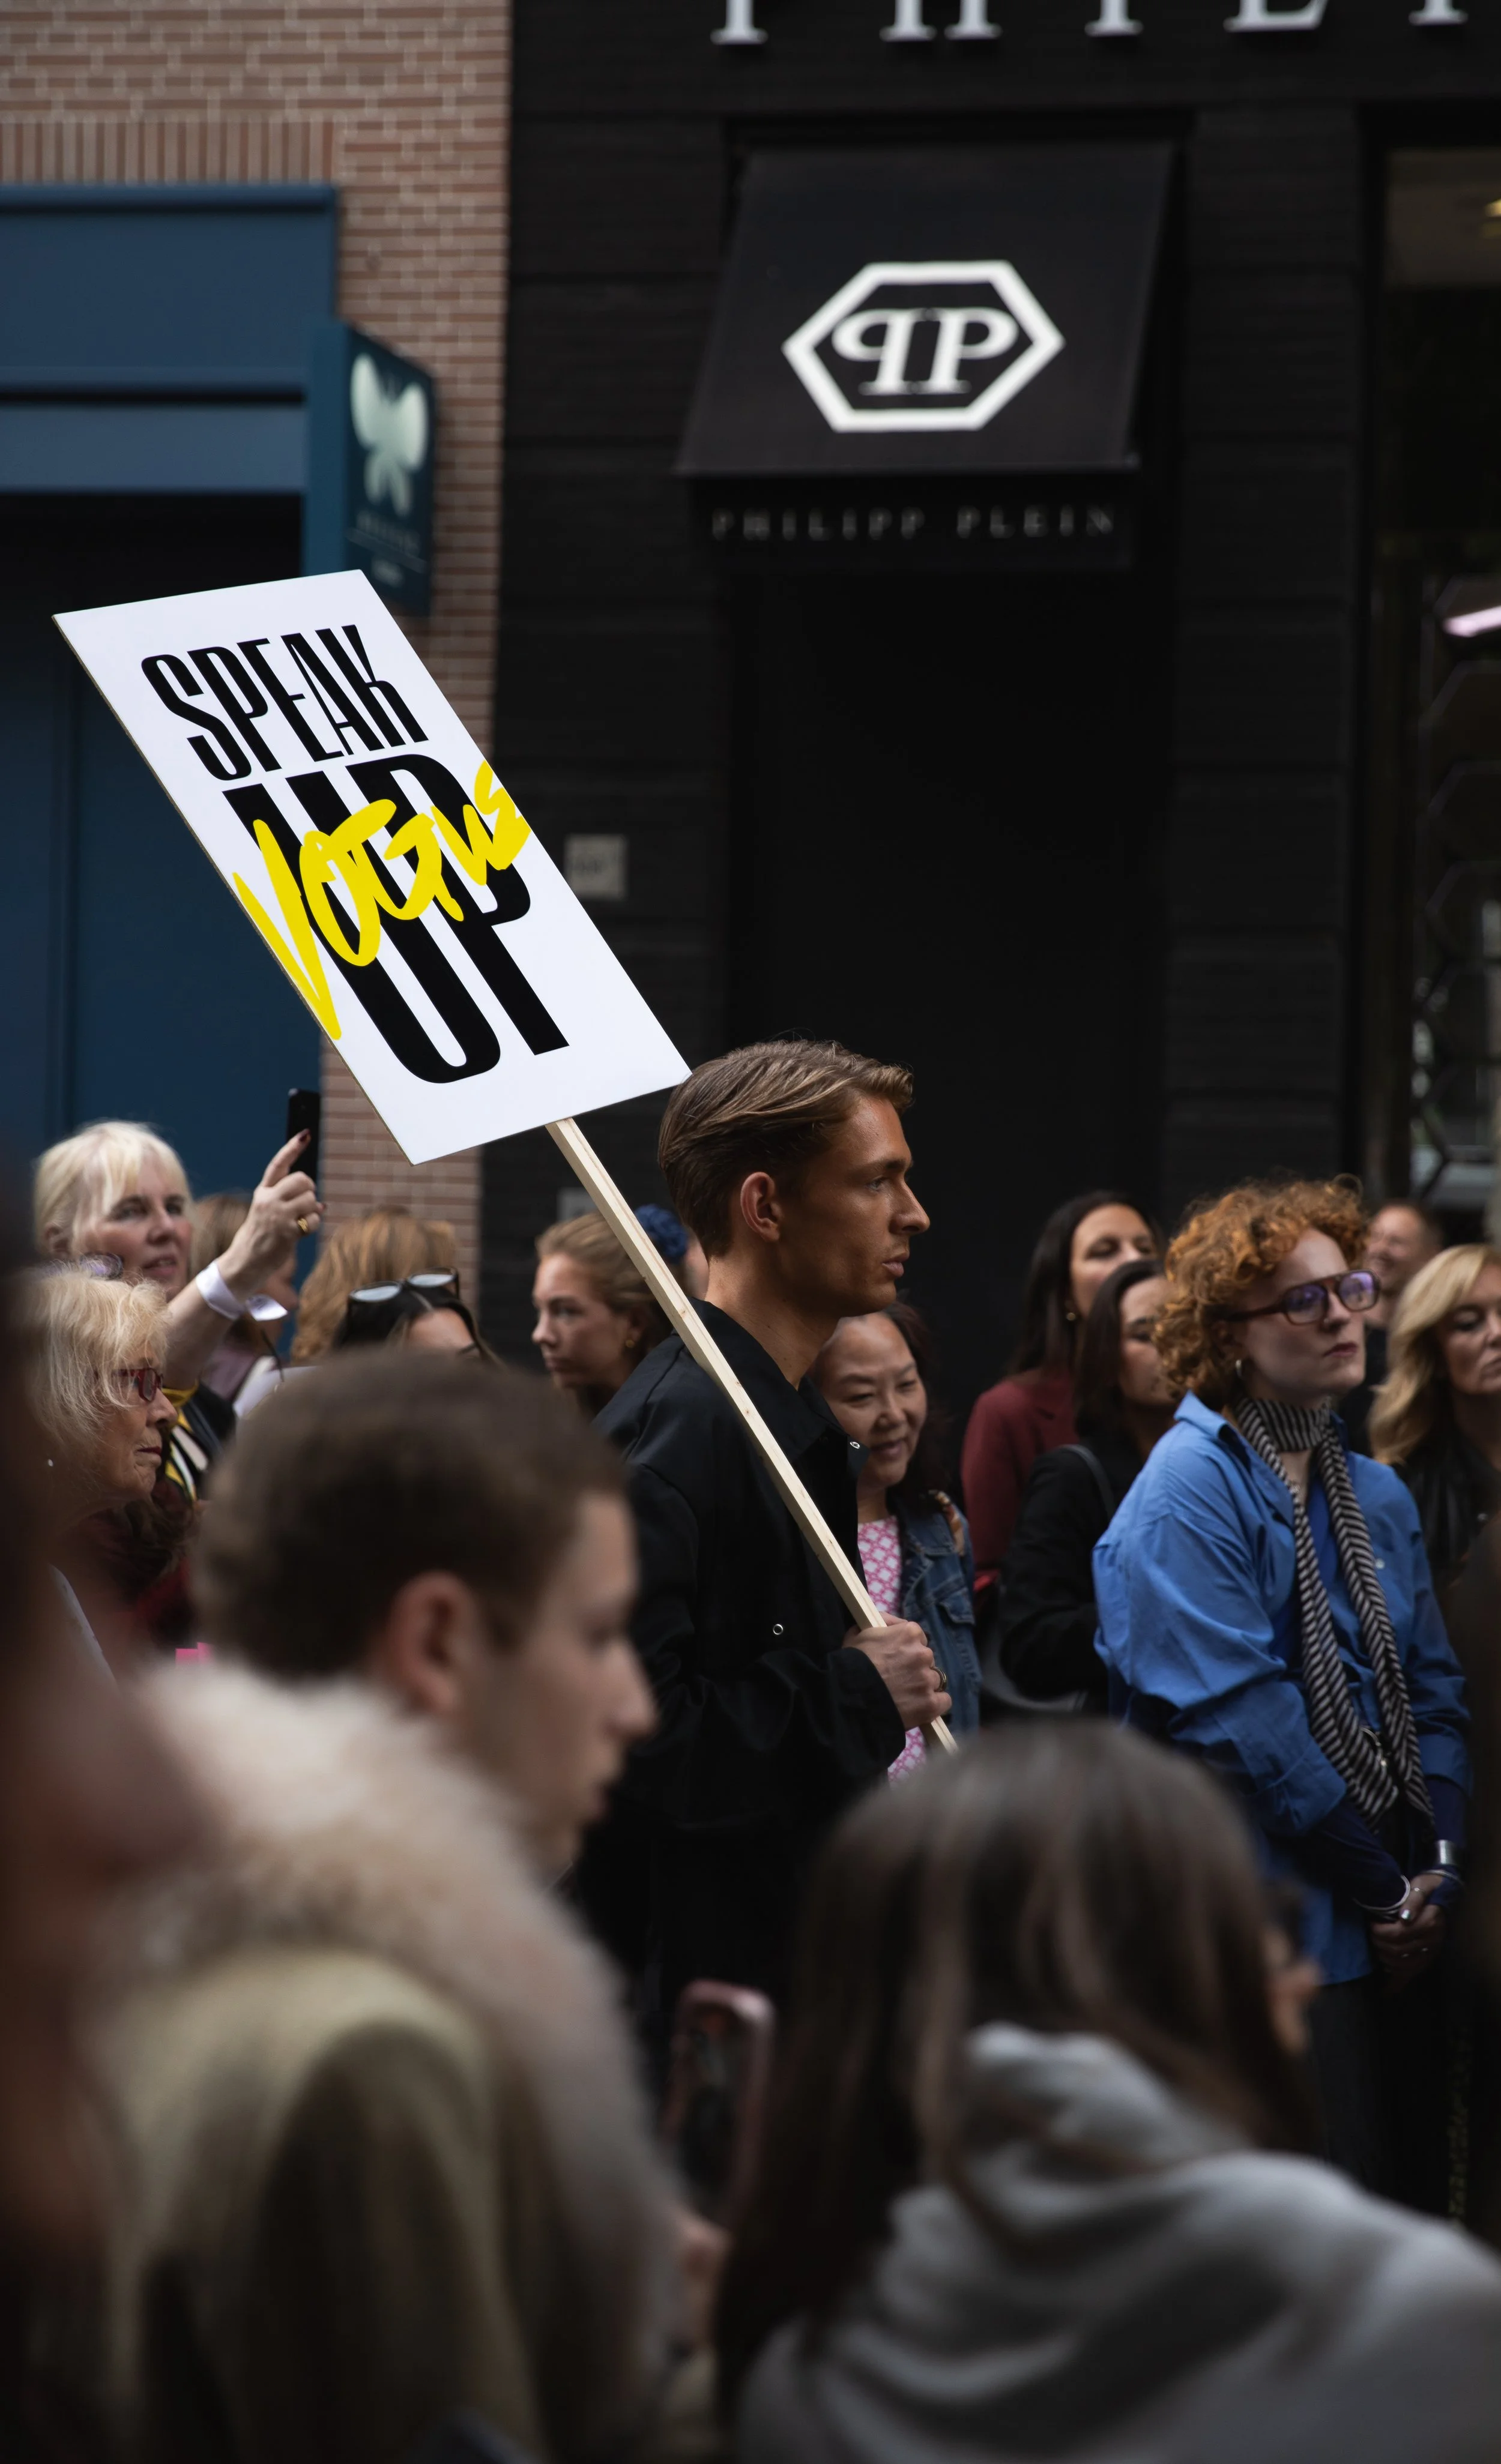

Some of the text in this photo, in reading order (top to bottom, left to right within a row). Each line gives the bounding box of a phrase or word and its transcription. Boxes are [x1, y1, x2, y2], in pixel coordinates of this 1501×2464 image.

[712, 504, 1114, 540] PHILIPP PLEIN
[142, 625, 428, 780] SPEAK
[222, 755, 569, 1083] UP
